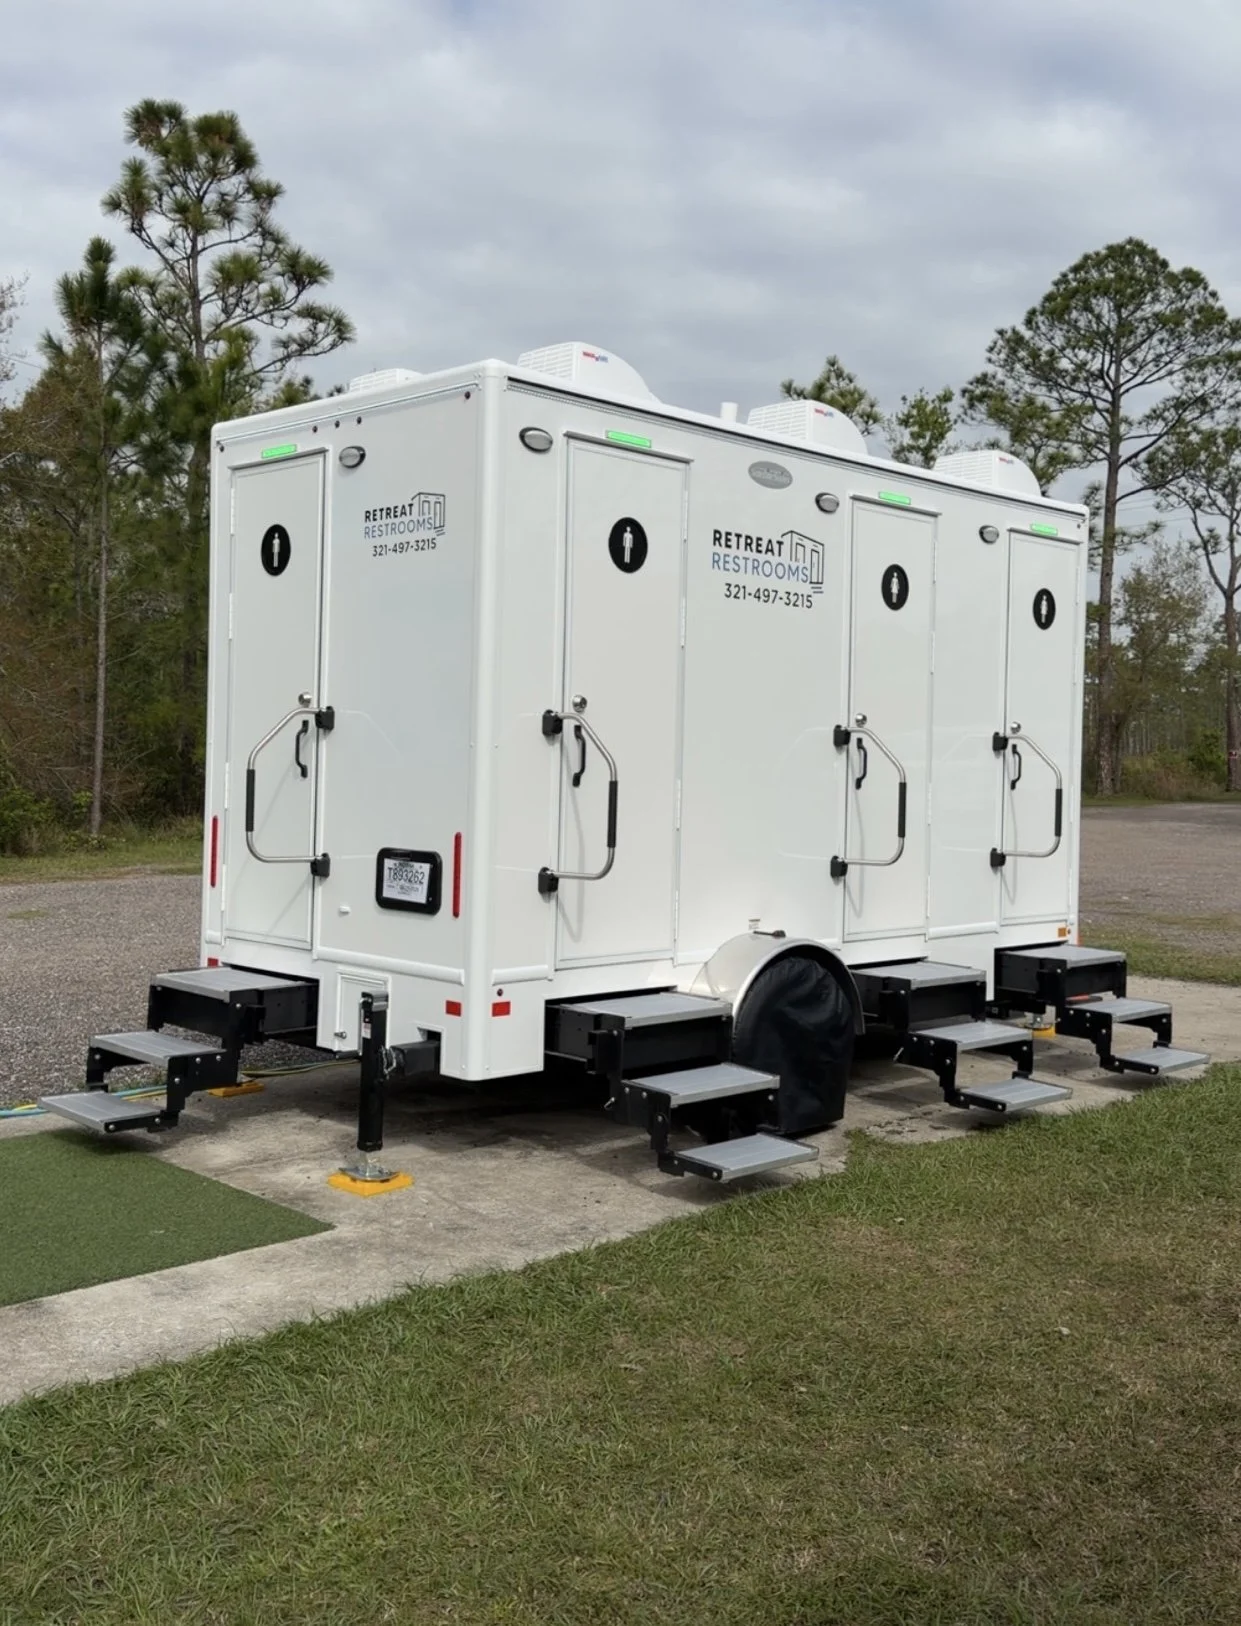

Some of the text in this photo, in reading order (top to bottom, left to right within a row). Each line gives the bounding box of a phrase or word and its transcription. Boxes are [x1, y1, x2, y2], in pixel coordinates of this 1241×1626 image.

[364, 503, 414, 523] RETREAT
[364, 516, 433, 539] RESTROOMS
[372, 537, 437, 557] 321-497-3215
[713, 529, 784, 557] RETREAT
[712, 552, 809, 583] RESTROOMS
[724, 582, 813, 609] 321-497-3215
[387, 866, 425, 884] T893262
